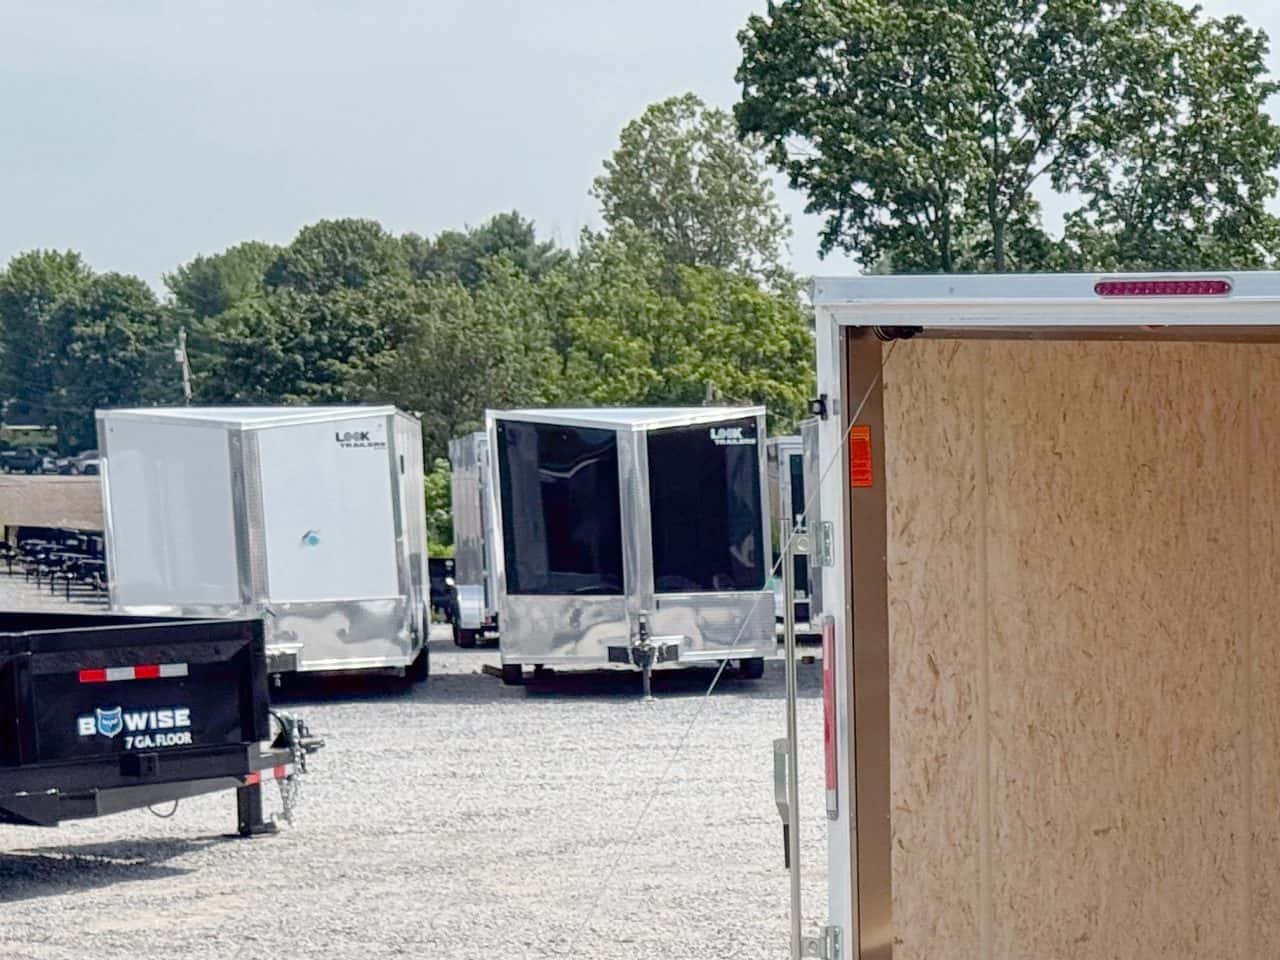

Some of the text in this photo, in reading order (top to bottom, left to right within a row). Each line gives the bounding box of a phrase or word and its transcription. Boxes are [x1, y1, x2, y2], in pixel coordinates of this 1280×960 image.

[335, 431, 370, 442] LOOK
[710, 427, 744, 440] LOOK
[125, 736, 134, 750] 7
[155, 731, 193, 747] FLOOR
